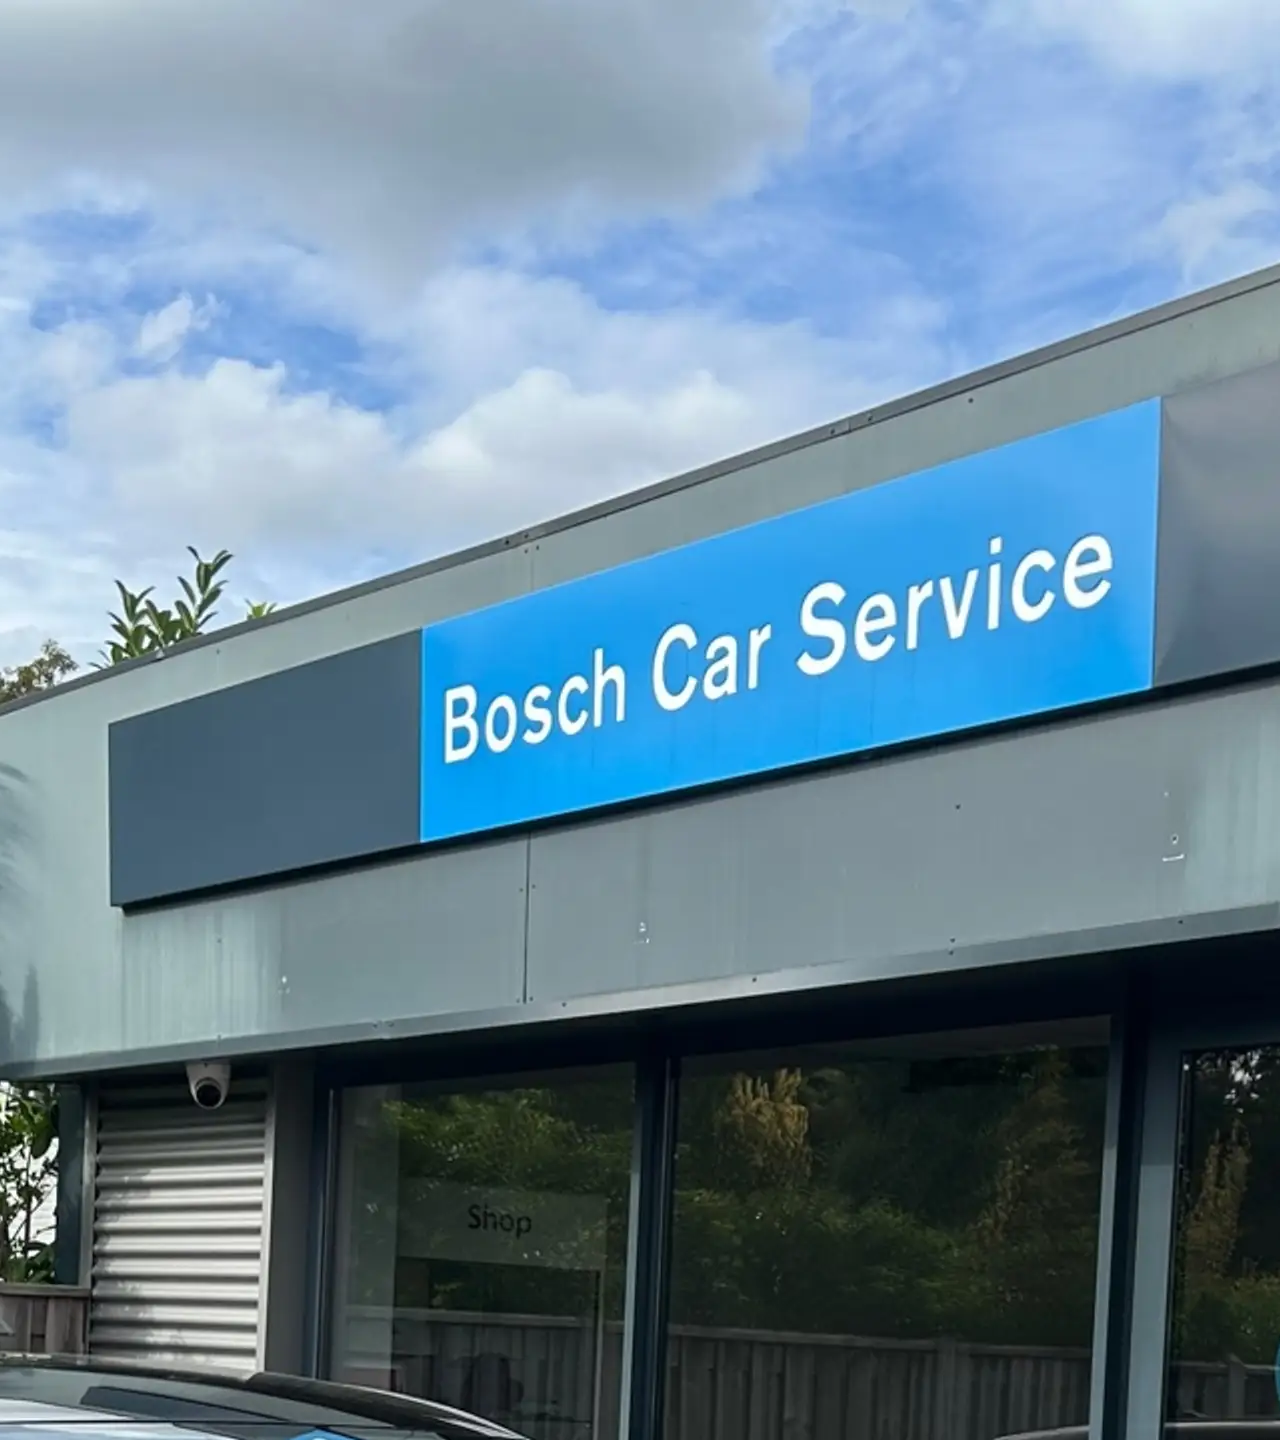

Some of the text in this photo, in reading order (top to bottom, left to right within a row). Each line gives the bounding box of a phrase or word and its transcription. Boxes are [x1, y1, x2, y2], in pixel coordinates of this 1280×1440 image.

[443, 534, 1113, 764] Bosch Car Service
[467, 1203, 532, 1238] Shop
